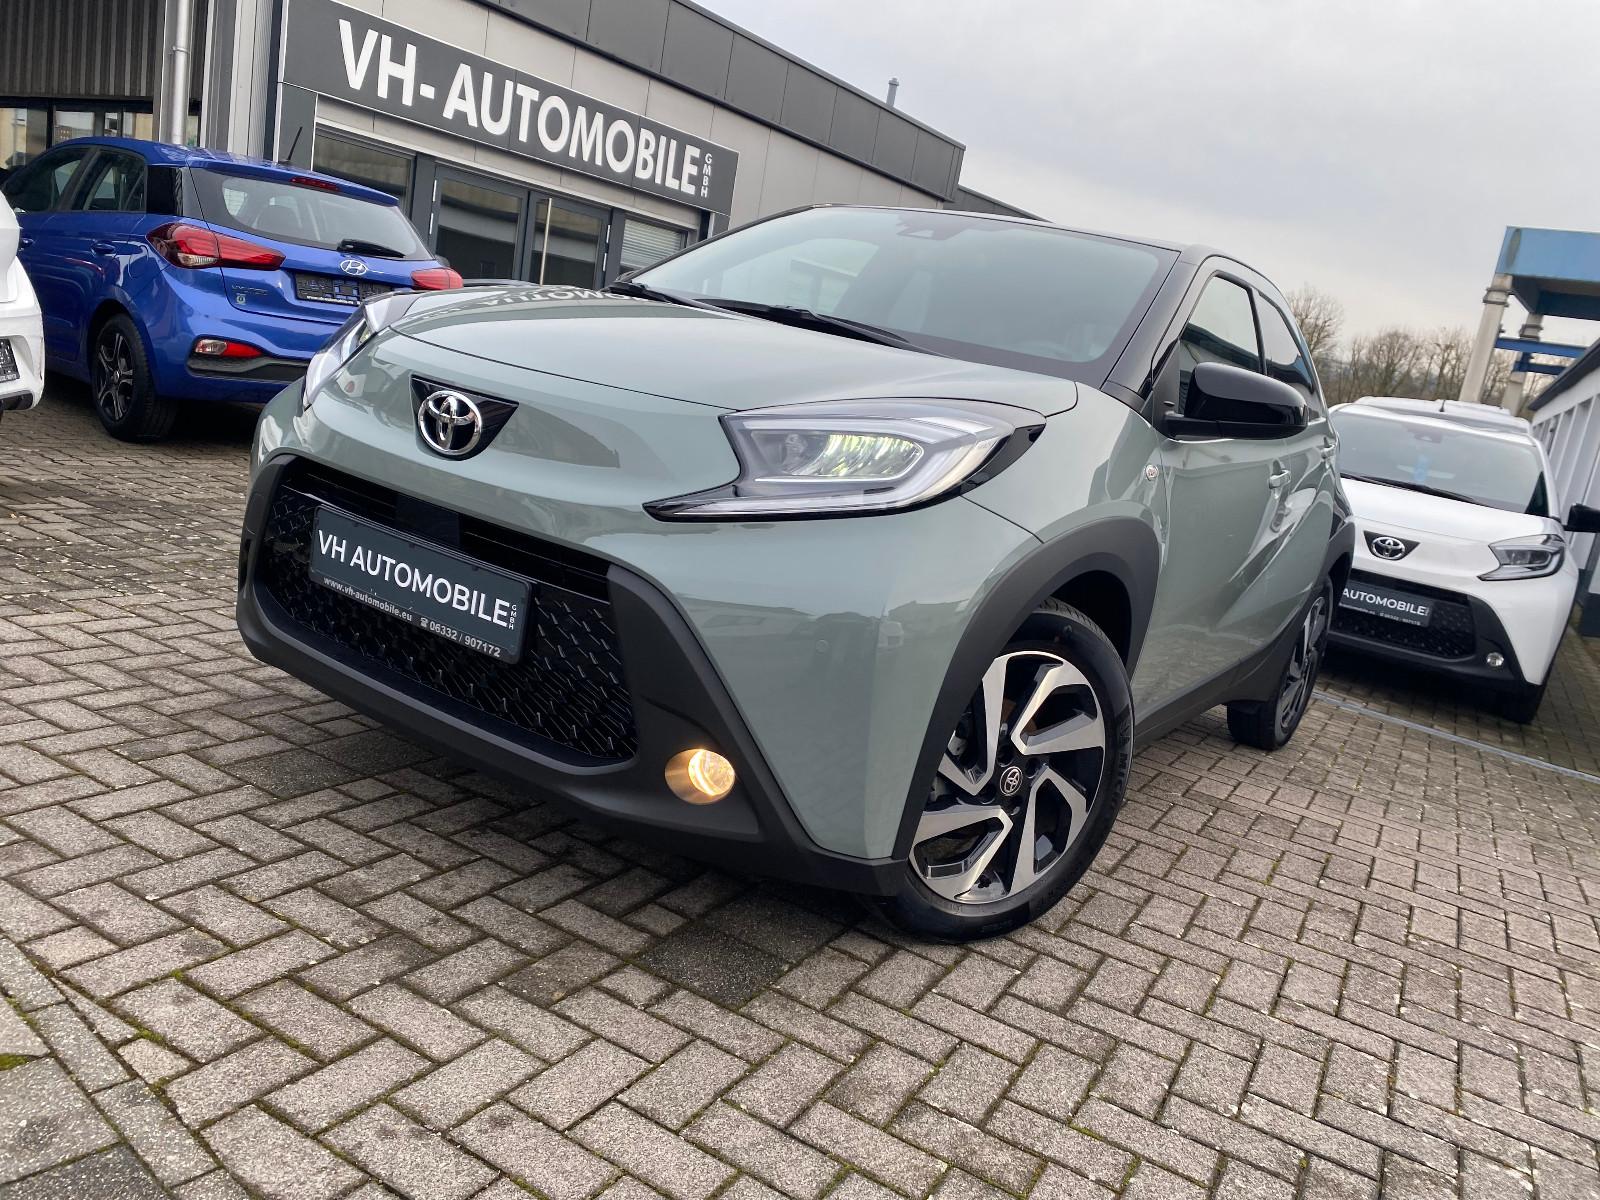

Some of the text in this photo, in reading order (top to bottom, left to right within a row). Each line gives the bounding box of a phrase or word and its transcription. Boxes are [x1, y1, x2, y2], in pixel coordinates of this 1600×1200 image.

[318, 530, 510, 627] VH AUTOMOBILE
[323, 577, 413, 621] www.vh-automobile.eu
[429, 621, 458, 640] 06332
[464, 635, 501, 658] 907172
[1342, 588, 1427, 615] AUTOMOBILE
